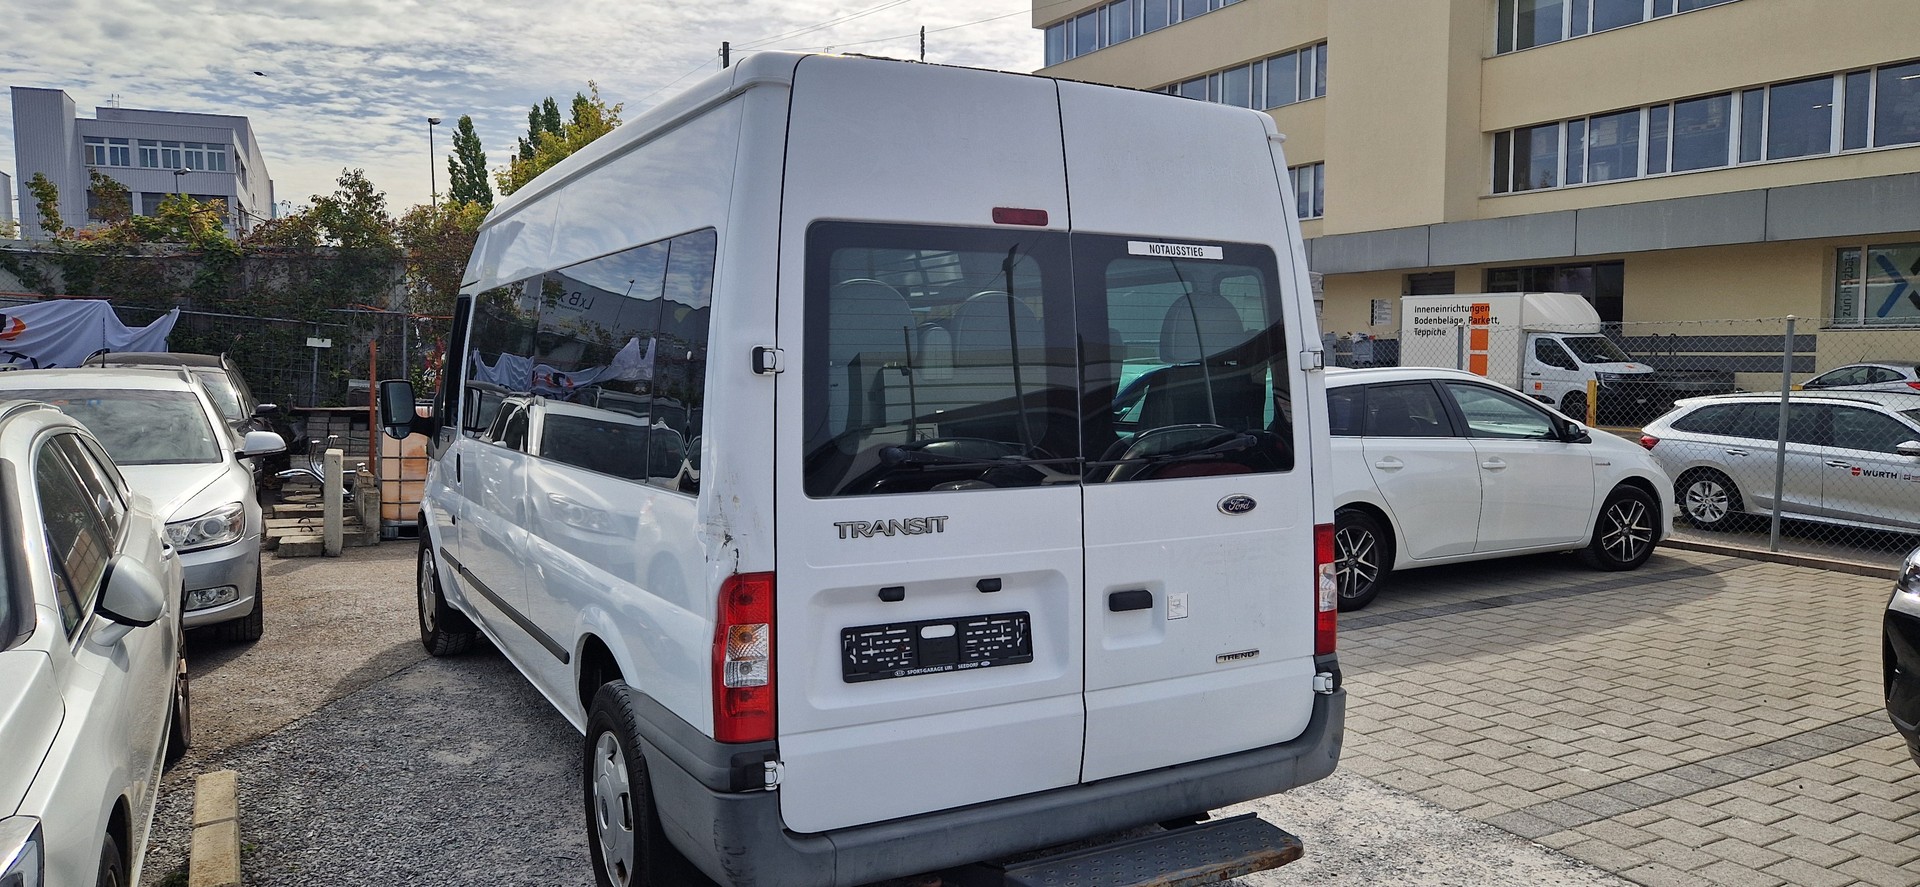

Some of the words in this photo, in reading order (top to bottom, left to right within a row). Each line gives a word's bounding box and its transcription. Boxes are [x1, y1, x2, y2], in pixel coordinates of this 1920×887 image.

[1149, 244, 1204, 257] NOTAUSSTIEG
[1414, 303, 1490, 314] Inneneinrichtungen
[1414, 316, 1466, 326] Bodenbeläge,
[1468, 316, 1500, 325] Parkett,
[1414, 327, 1447, 337] Teppiche
[1863, 469, 1898, 479] WÜRTH
[834, 515, 949, 540] TRANSIT
[1223, 652, 1255, 661] TREND
[906, 666, 944, 675] SPORT-GARAGE
